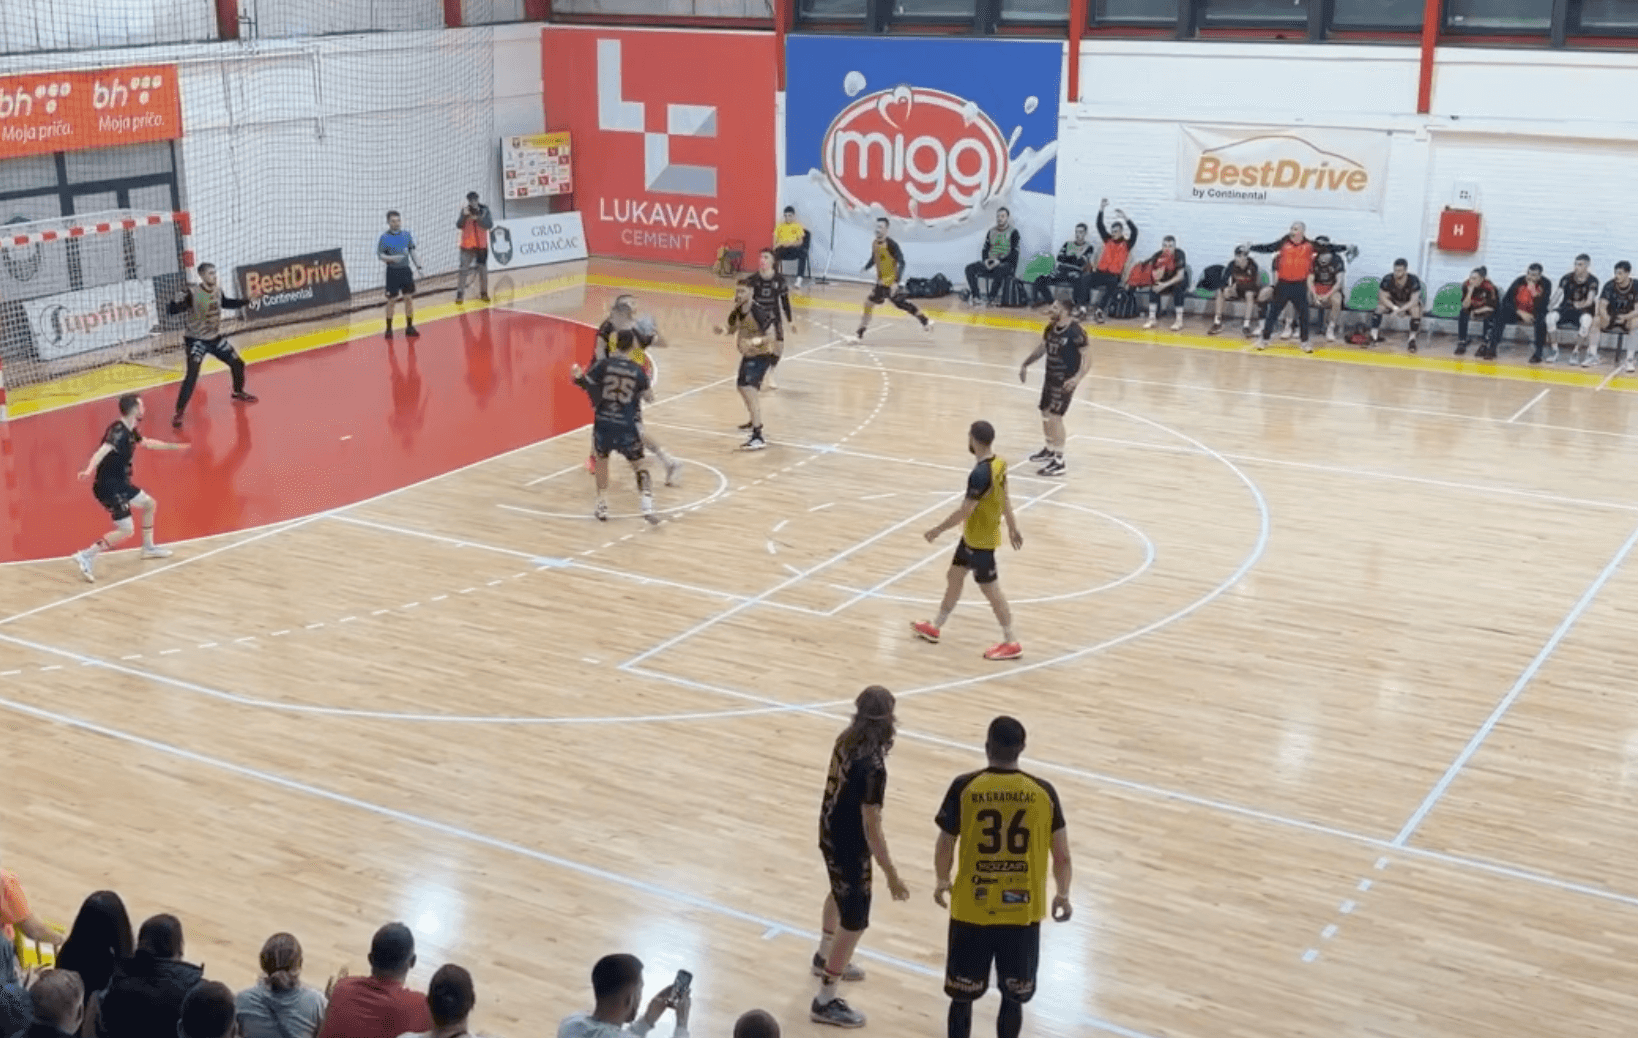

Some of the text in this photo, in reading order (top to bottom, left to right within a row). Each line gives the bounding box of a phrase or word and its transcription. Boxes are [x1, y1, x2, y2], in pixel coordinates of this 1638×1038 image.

[2, 124, 36, 144] Moja
[99, 115, 130, 134] Moja
[1194, 155, 1368, 192] BestDrive
[1192, 187, 1267, 200] by Continental
[599, 198, 719, 231] LUKAVAC
[531, 223, 562, 238] GRAD
[621, 228, 693, 250] CEMENT
[1453, 224, 1464, 236] H
[519, 236, 580, 256] GRADAČAC
[245, 259, 343, 297] BestDrive
[262, 286, 314, 307] Continental
[602, 375, 636, 404] 25
[976, 808, 1030, 854] 36
